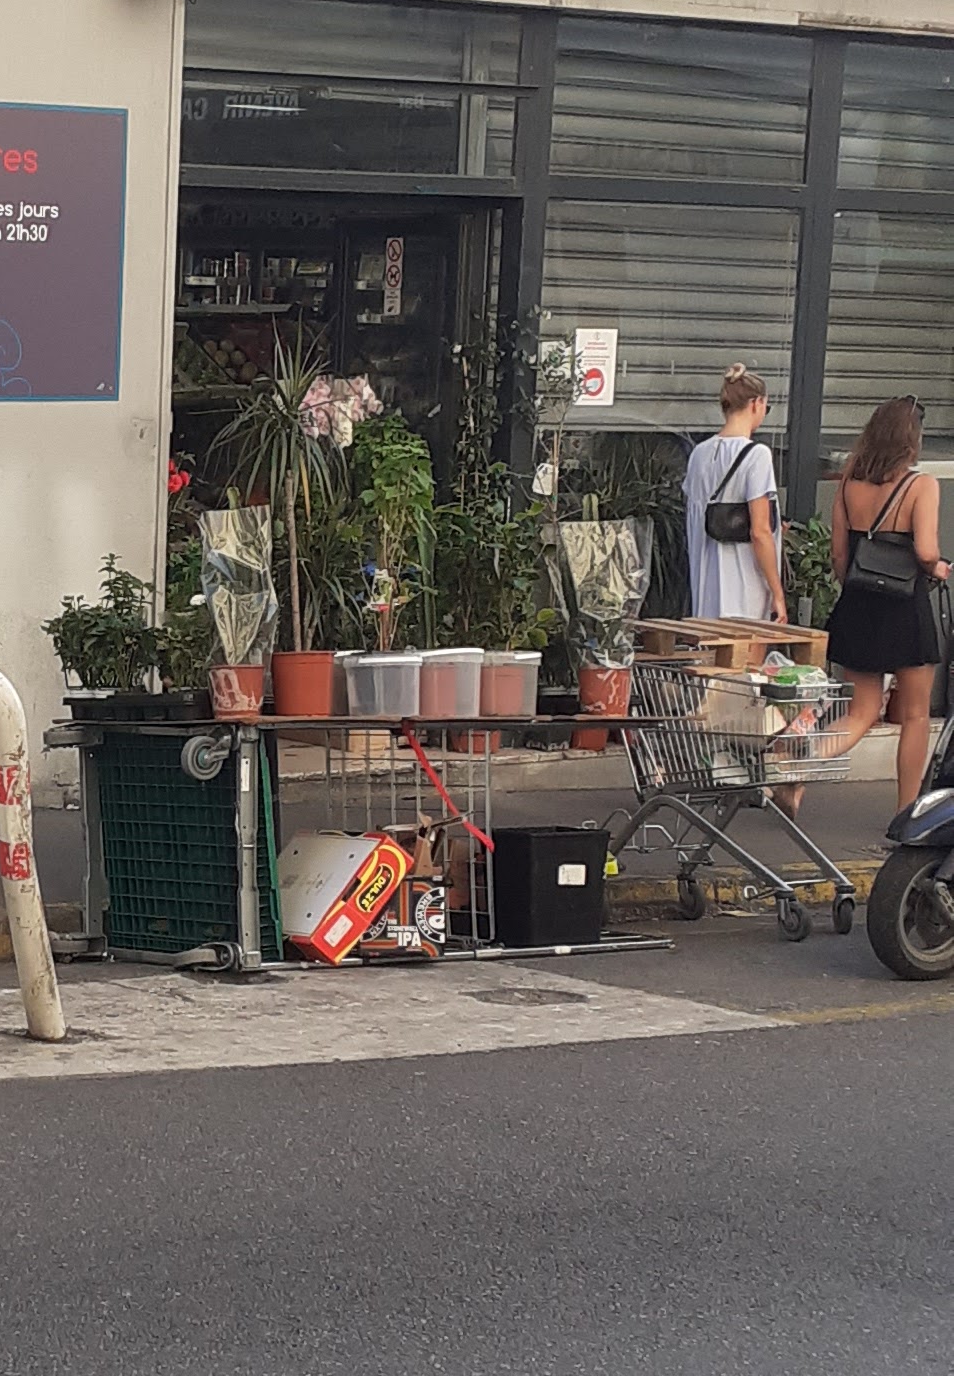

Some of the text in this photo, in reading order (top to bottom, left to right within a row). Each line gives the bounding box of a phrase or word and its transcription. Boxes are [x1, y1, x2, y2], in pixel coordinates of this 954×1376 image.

[17, 201, 59, 221] jours
[6, 224, 48, 241] 21h30
[397, 932, 421, 947] IPA
